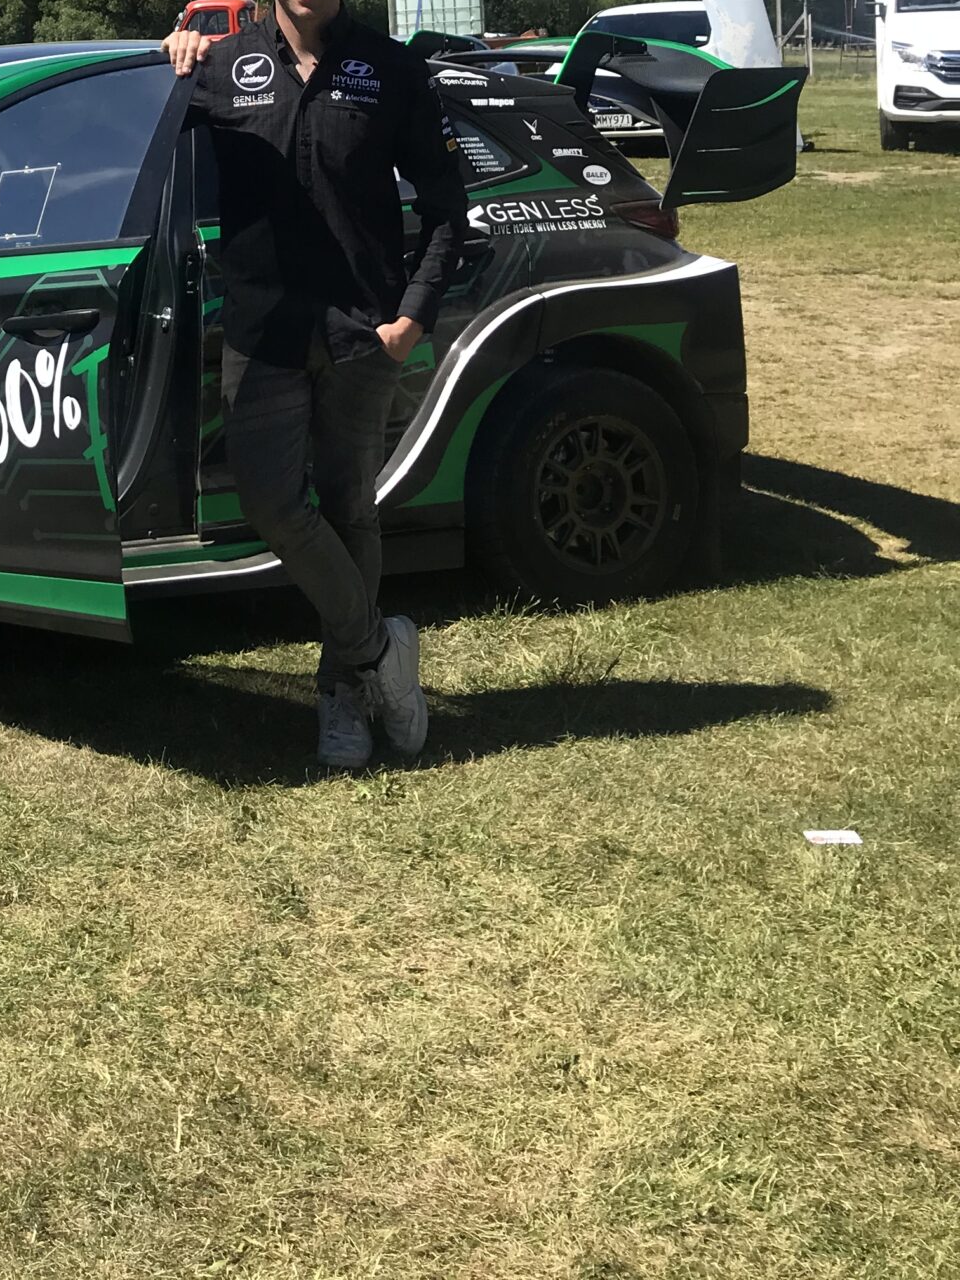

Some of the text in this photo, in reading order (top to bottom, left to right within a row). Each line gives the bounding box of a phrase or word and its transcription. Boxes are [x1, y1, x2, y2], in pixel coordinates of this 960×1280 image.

[332, 73, 381, 88] HYUNDAI
[488, 97, 515, 107] Repco
[552, 148, 583, 156] GRAVITY
[492, 219, 607, 235] LIVE MORE WITH LESS ENERGY
